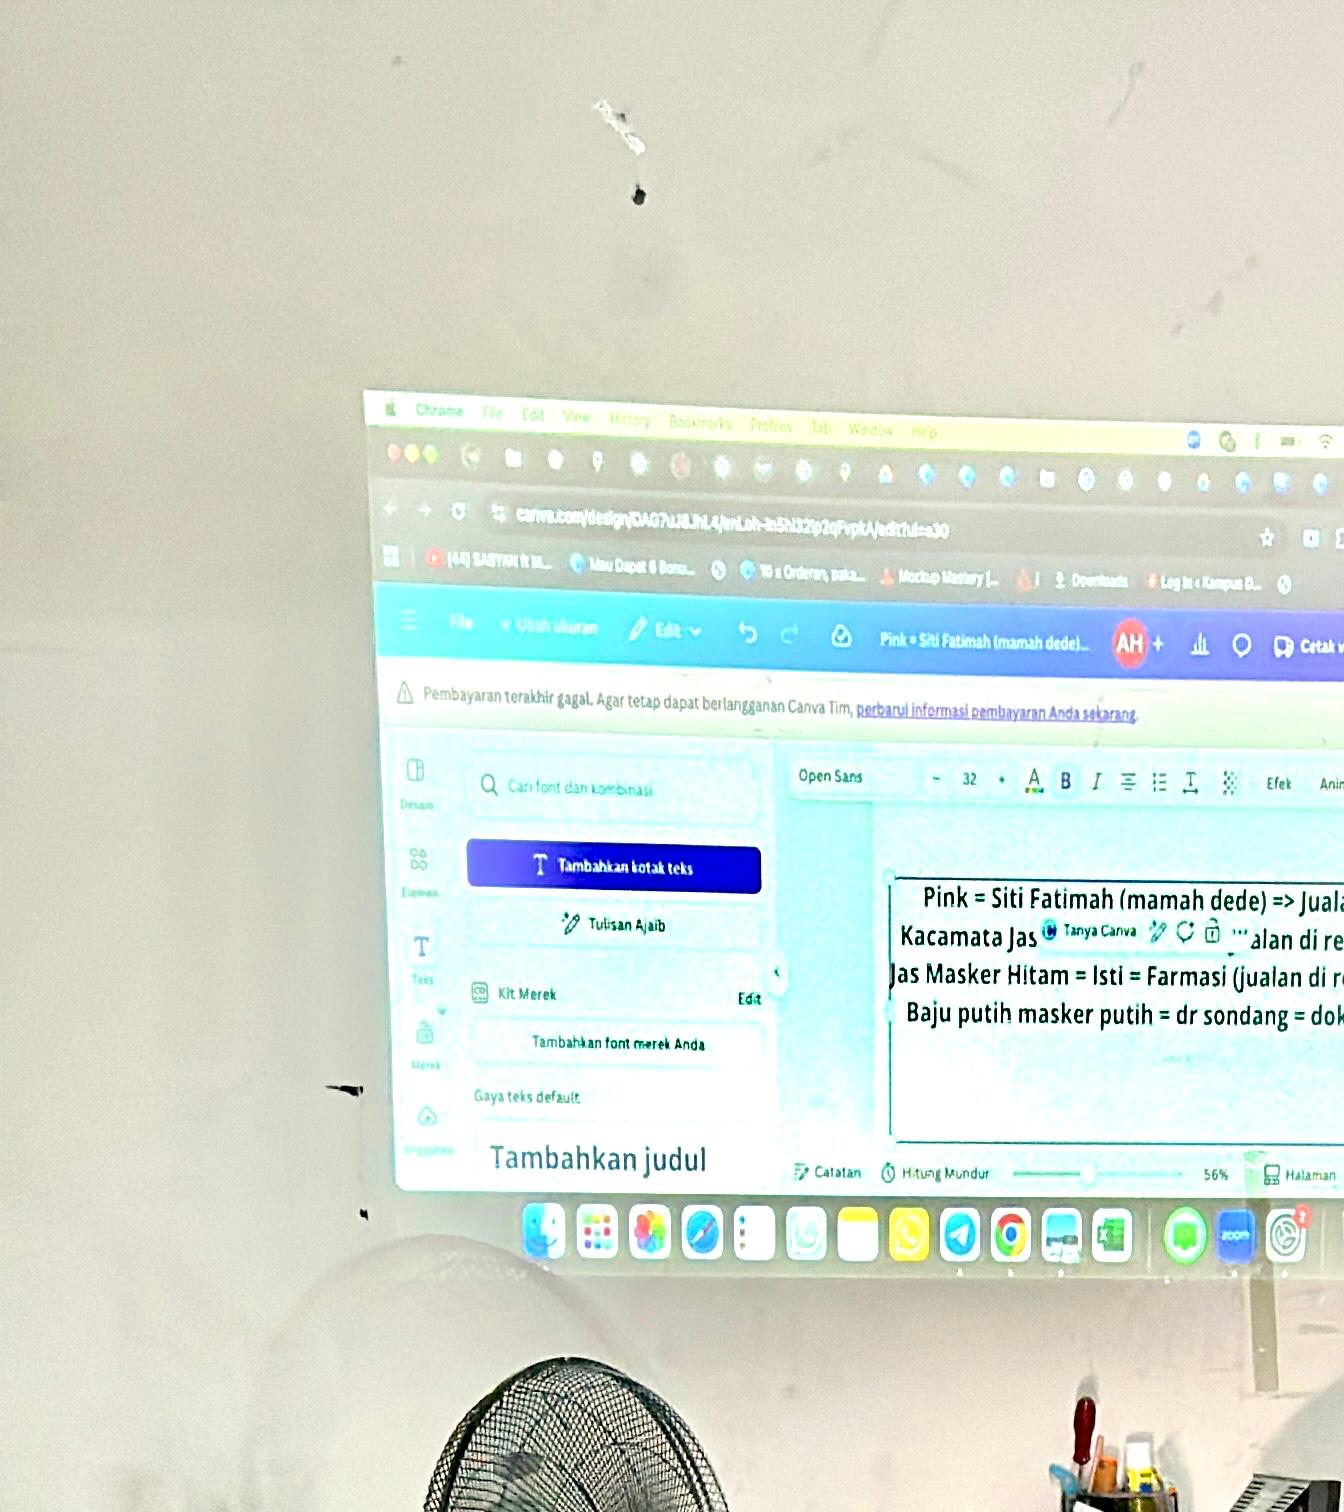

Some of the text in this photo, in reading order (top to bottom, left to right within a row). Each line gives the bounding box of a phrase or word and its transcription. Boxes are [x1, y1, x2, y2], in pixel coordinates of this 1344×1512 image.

[415, 403, 464, 418] Chrome
[482, 405, 503, 419] File
[522, 406, 545, 422] Edit
[563, 409, 591, 424] View
[610, 411, 651, 429] History
[669, 415, 733, 431] Bookmarks
[811, 420, 831, 435] Tab
[850, 423, 894, 437] Window
[912, 424, 938, 440] Help
[655, 622, 681, 638] Edit
[880, 632, 907, 648] Pink
[919, 633, 939, 648] Siti
[942, 634, 991, 649] Fatimah
[1117, 634, 1144, 653] AH
[1300, 638, 1334, 654] Cetak
[424, 686, 501, 705] Pembayaran
[505, 689, 553, 705] terakhir
[557, 691, 594, 709] gagal.
[596, 692, 624, 711] Agar
[627, 693, 660, 711] tetap
[664, 695, 700, 712] dapat
[702, 696, 785, 716] berlangganan
[788, 699, 825, 715] Canva
[829, 700, 853, 718] Tim,
[857, 702, 908, 719] perbarui
[912, 703, 968, 719] informasi
[971, 705, 1046, 722] pembayaran
[1049, 706, 1080, 720] Anda
[799, 768, 863, 784] Open Sans
[963, 772, 977, 786] 32
[1267, 777, 1291, 790] Efek
[509, 780, 532, 793] Cari
[537, 780, 560, 793] font
[565, 782, 588, 795] dan
[558, 857, 693, 877] Tambahkan kotak teks
[924, 886, 968, 908] Pink
[992, 887, 1023, 909] Siti
[1031, 888, 1114, 910] Fatimah
[1120, 888, 1203, 912] (mamah
[1210, 889, 1267, 915] dede)
[589, 918, 666, 936] Tulisan Ajaib
[1065, 924, 1136, 940] Tanya Canva
[901, 925, 1002, 948] Kacamata
[1007, 926, 1038, 953] Jas
[1300, 929, 1318, 951] di
[889, 963, 919, 990] Jas
[926, 963, 1001, 984] Masker
[1008, 964, 1069, 985] Hitam
[1093, 965, 1123, 986] Isti
[1147, 965, 1226, 987] Farmasi
[1233, 966, 1301, 993] (jualan
[1309, 966, 1326, 987] di
[499, 987, 556, 1002] Kit Merek
[738, 992, 761, 1006] Edit
[907, 1001, 951, 1029] Baju
[958, 1001, 1011, 1028] putih
[1018, 1002, 1094, 1025] masker
[1101, 1003, 1153, 1031] putih
[1176, 1004, 1198, 1026] dr
[1204, 1005, 1288, 1032] sondang
[532, 1035, 705, 1051] Tambahkan font merek Anda
[474, 1089, 580, 1106] Gaya teks default
[490, 1145, 706, 1179] Tambahkan judul
[814, 1166, 862, 1179] Catatan
[903, 1166, 990, 1183] Hitung Mundur
[1204, 1168, 1229, 1181] 56%
[1286, 1169, 1336, 1182] Halaman
[1221, 1231, 1249, 1241] zoom
